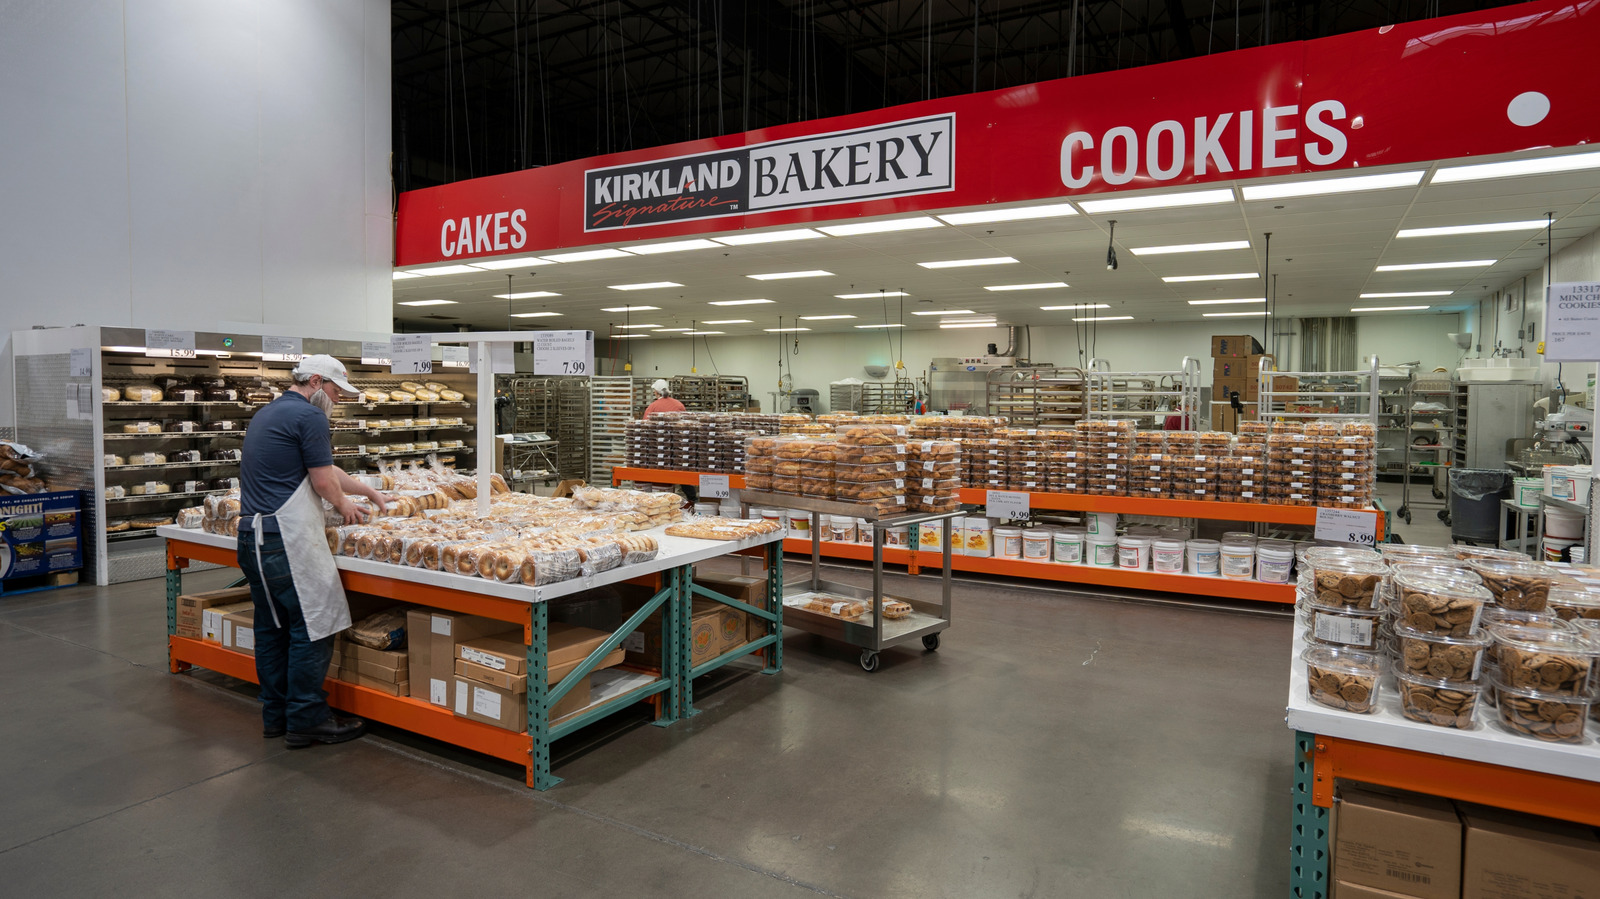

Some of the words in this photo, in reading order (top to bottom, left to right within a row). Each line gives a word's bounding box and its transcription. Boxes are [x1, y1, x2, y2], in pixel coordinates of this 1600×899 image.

[1060, 100, 1347, 189] COOKIES
[754, 131, 943, 198] BAKERY
[595, 159, 742, 204] KIRKLAND
[592, 195, 739, 227] Signature
[441, 209, 527, 257] CAKES
[170, 348, 195, 357] 15.99
[413, 361, 431, 372] 7.99
[563, 361, 585, 374] 7.99
[1011, 510, 1029, 519] 9.99
[1348, 533, 1374, 543] 8.99
